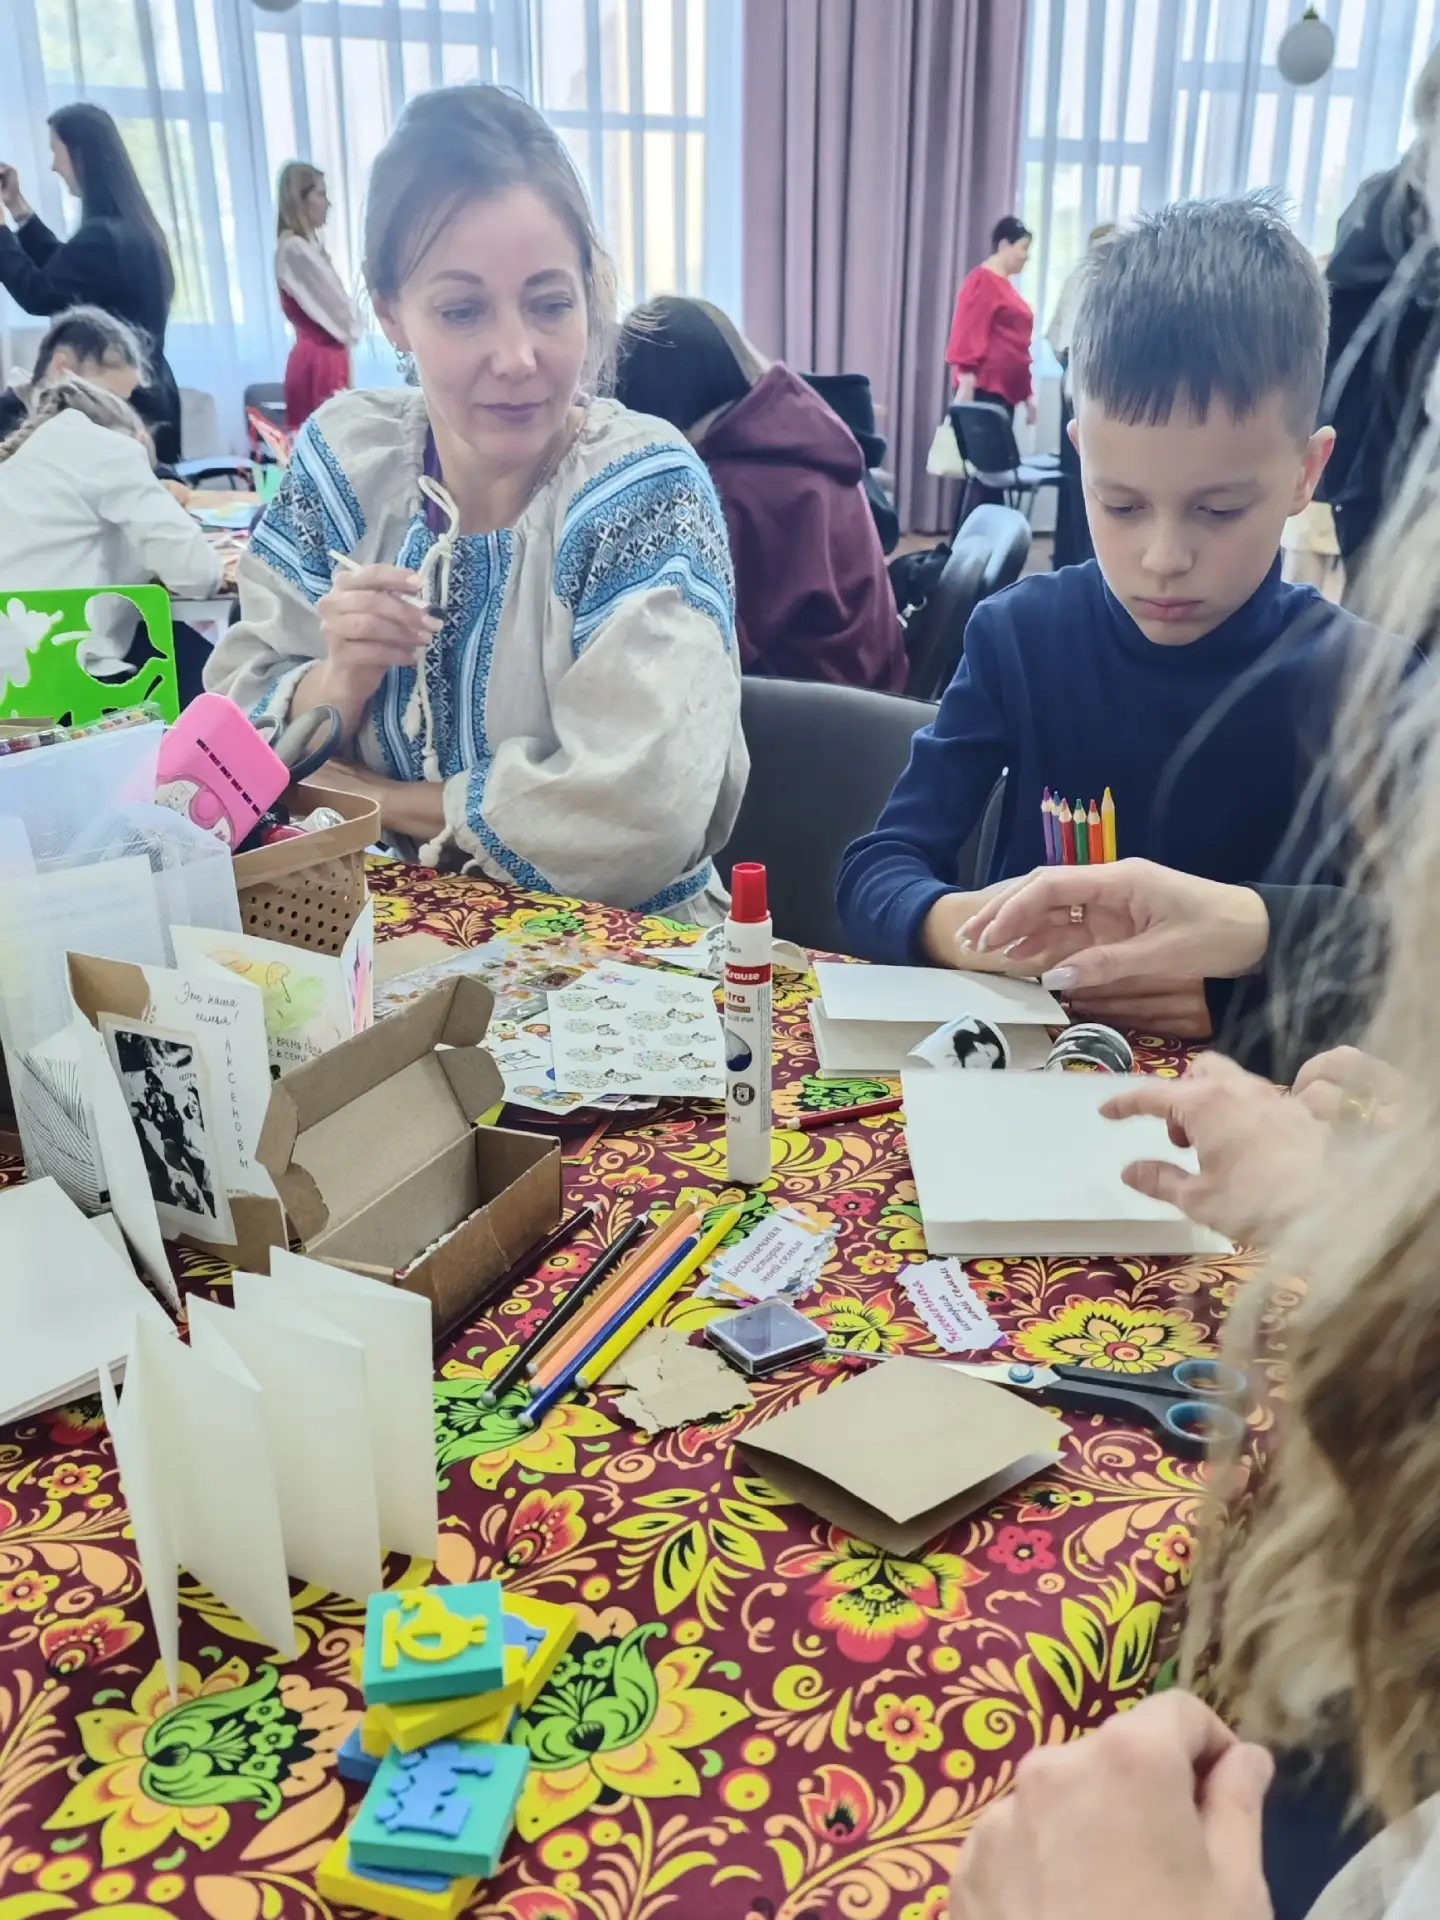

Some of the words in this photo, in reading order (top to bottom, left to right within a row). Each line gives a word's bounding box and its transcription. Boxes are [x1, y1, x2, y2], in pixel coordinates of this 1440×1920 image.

[727, 1226, 783, 1278] Бесконечная
[751, 1241, 786, 1274] история
[760, 1262, 783, 1284] моей
[780, 1240, 804, 1265] семьи
[940, 1267, 964, 1298] семьи
[912, 1280, 962, 1344] Бесконечная
[939, 1295, 972, 1331] история
[957, 1301, 983, 1321] моей
